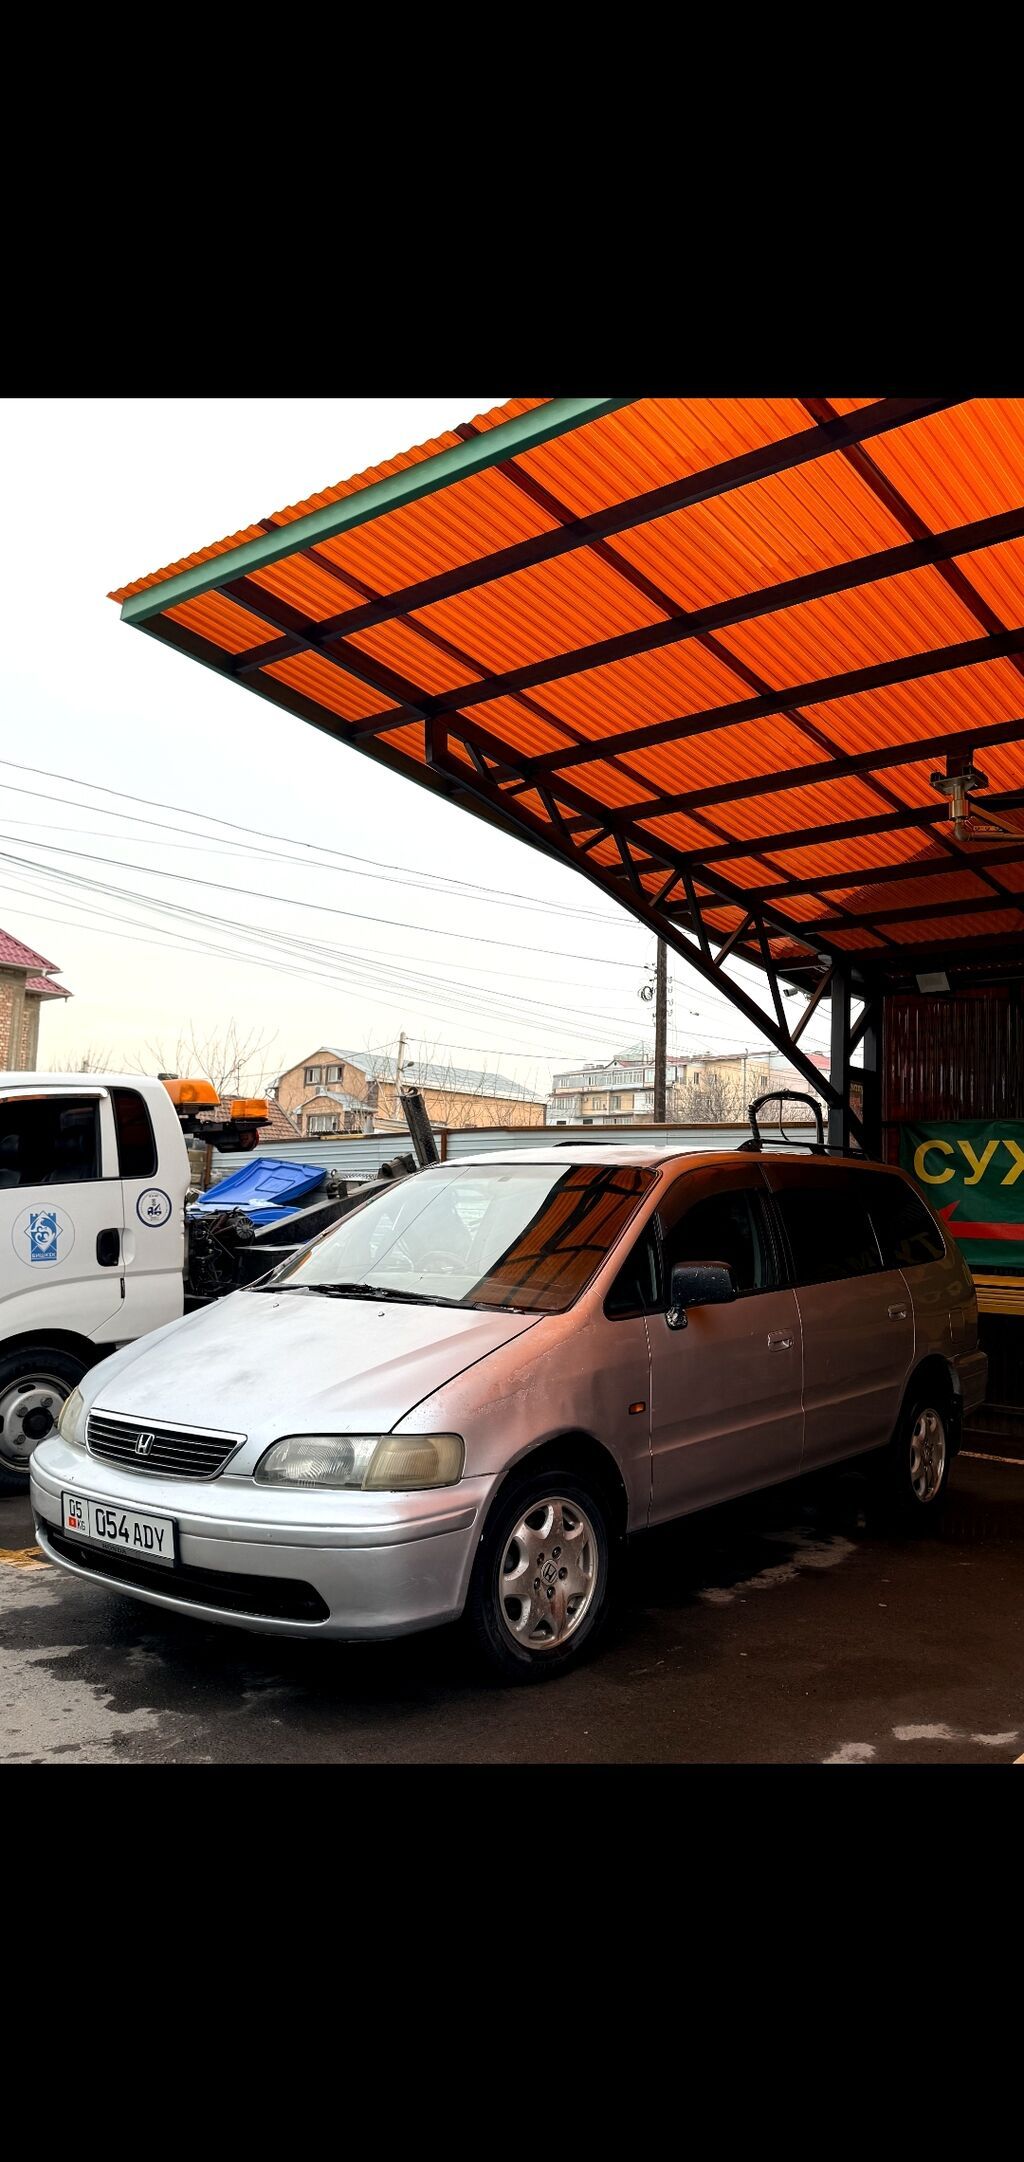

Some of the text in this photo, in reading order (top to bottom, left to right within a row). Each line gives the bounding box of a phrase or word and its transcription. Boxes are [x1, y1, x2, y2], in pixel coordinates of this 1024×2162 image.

[69, 1499, 82, 1519] 05
[77, 1519, 86, 1531] KG
[96, 1508, 164, 1552] 054 ADY
